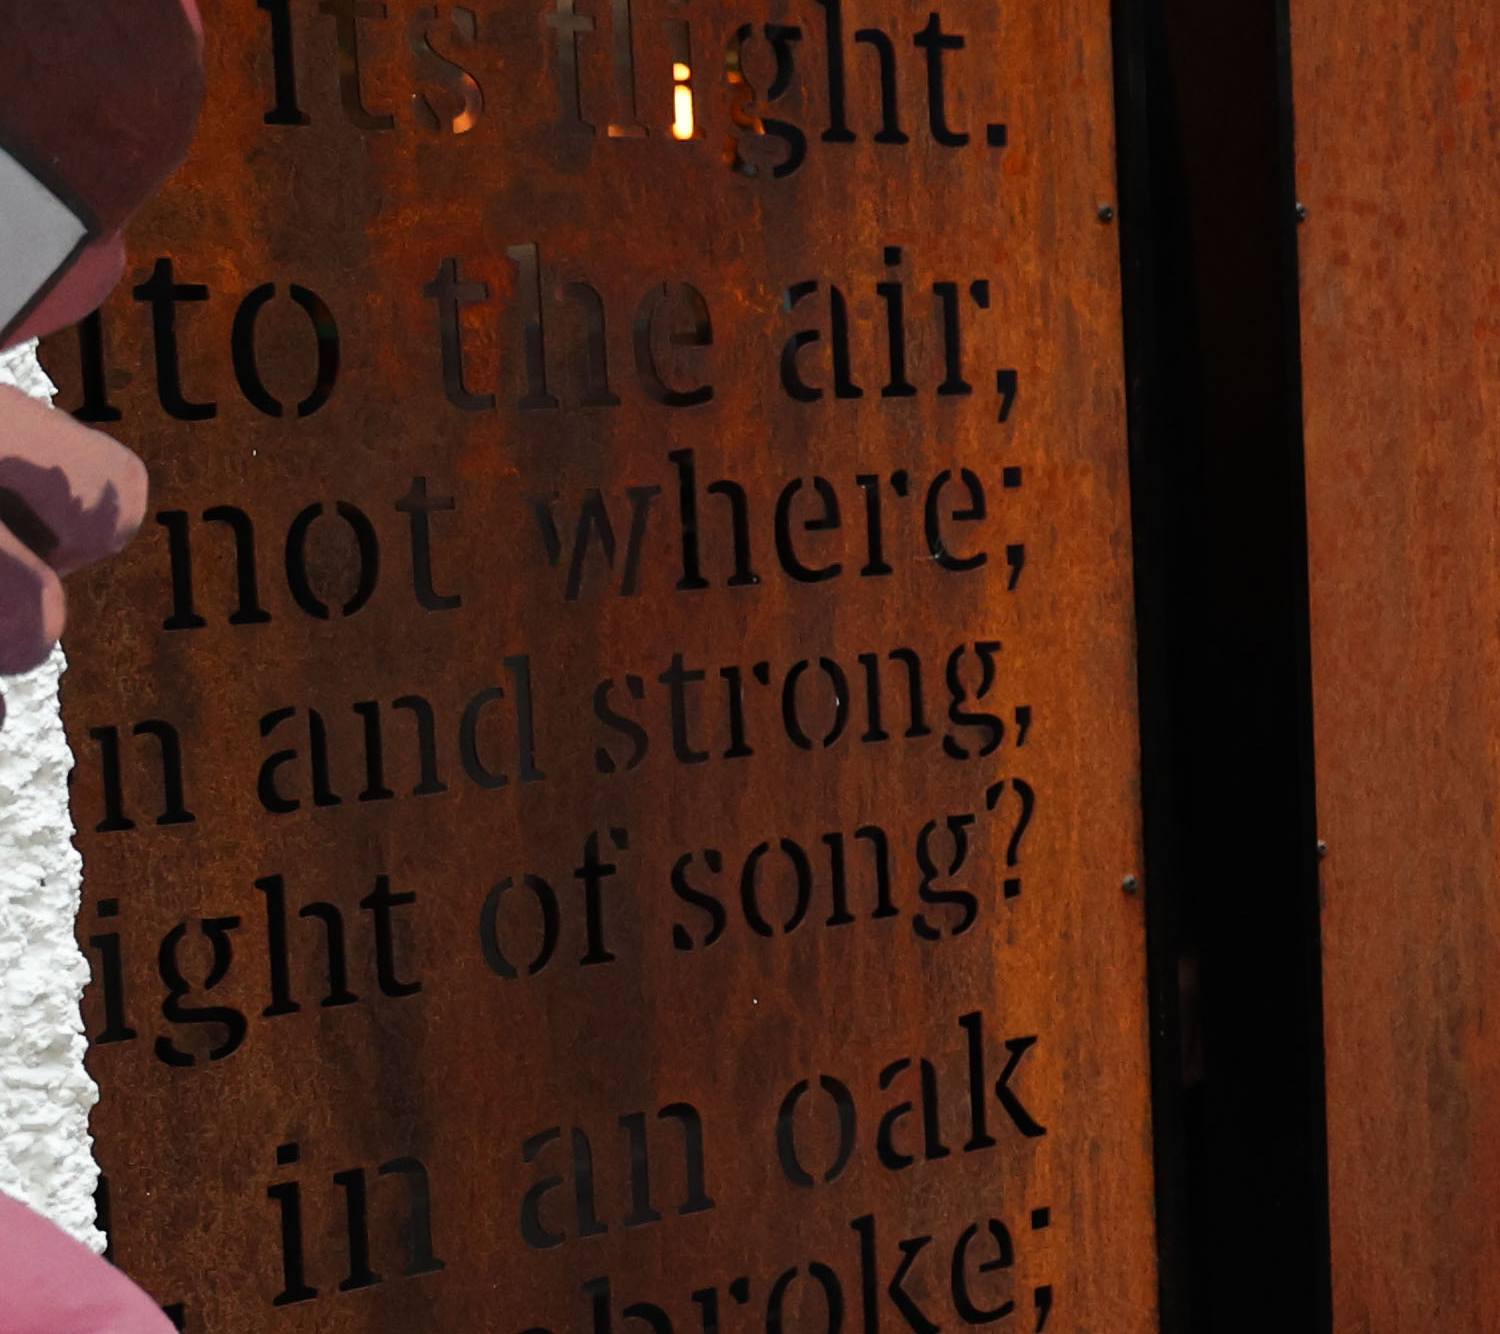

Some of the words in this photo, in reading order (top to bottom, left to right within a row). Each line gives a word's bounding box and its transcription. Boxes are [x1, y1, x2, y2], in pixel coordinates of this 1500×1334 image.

[424, 242, 714, 413] the
[778, 246, 1019, 424] air,
[155, 476, 461, 631] not
[527, 448, 1028, 604] where;
[255, 654, 546, 815] and
[594, 639, 1032, 775] strong,
[480, 827, 629, 981] of
[670, 777, 1036, 953] song?
[267, 1142, 444, 1308] in
[518, 1095, 715, 1250] an
[776, 1009, 1045, 1190] oak
